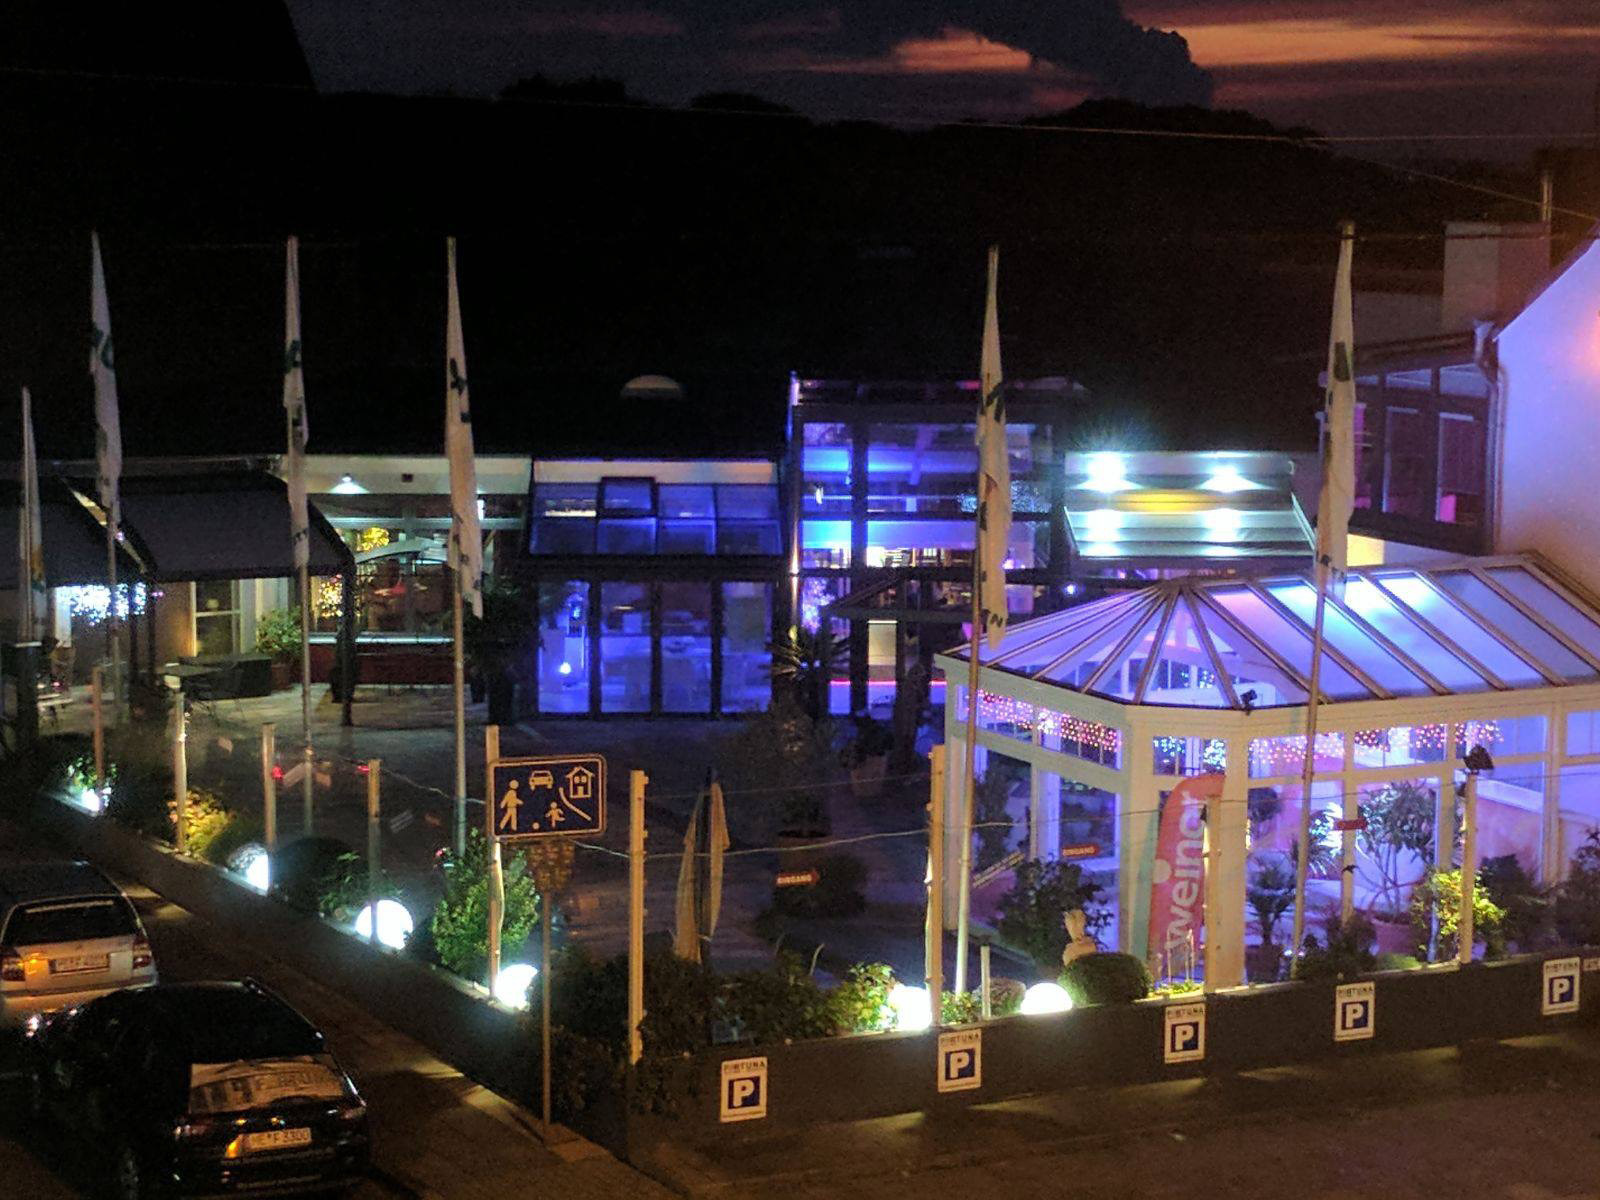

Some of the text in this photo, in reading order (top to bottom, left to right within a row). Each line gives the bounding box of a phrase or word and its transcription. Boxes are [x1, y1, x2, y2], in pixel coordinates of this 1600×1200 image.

[1155, 790, 1206, 950] weinor
[1552, 978, 1570, 1002] P
[1345, 1003, 1364, 1028] P
[1175, 1025, 1194, 1050] P
[950, 1052, 970, 1078] P
[733, 1079, 755, 1107] P
